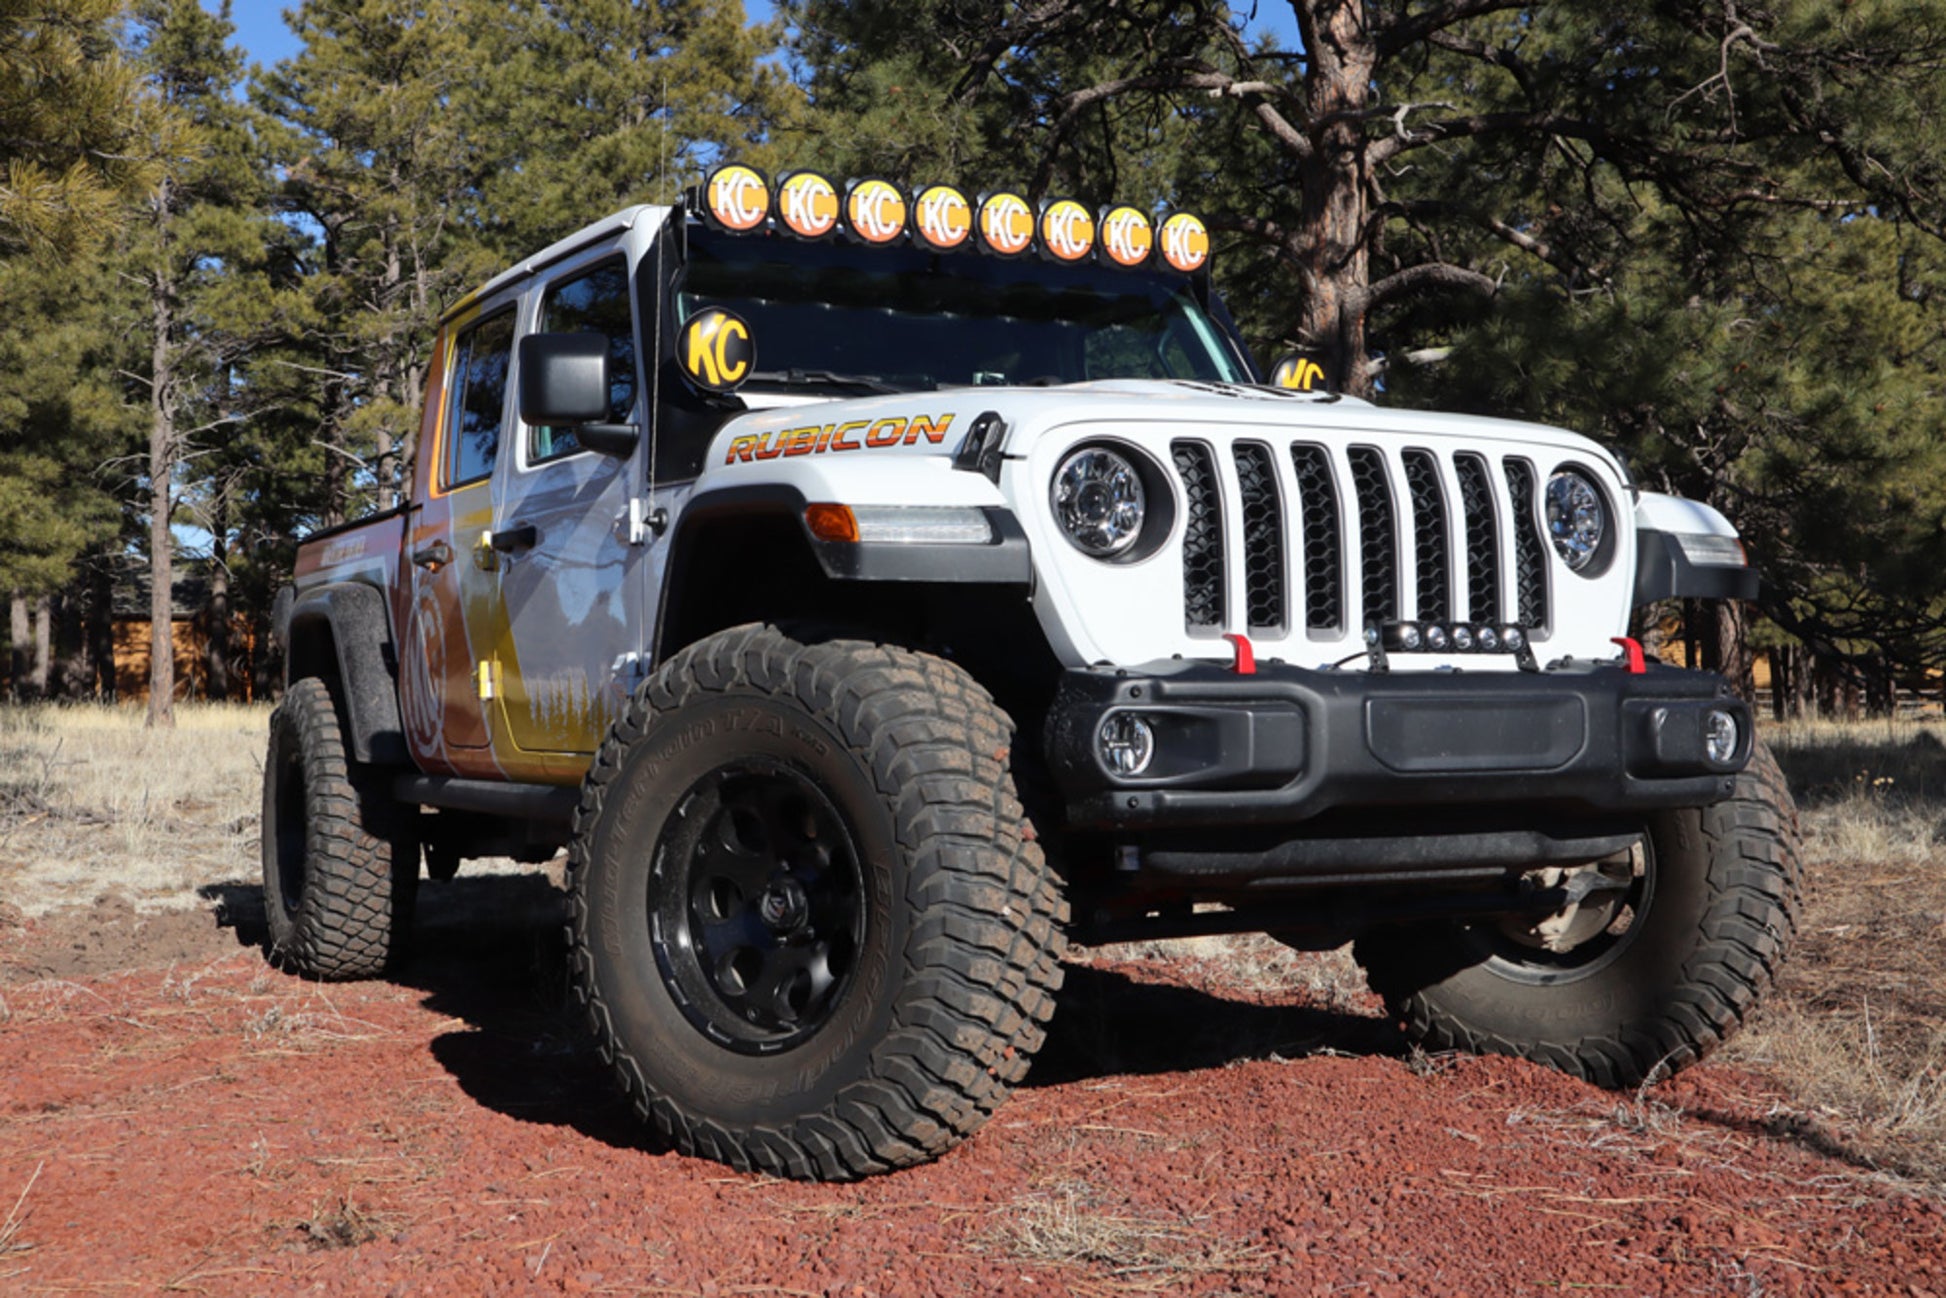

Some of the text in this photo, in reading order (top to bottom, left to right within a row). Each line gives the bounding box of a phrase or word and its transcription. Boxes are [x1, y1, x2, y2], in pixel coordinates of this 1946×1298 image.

[717, 171, 760, 224] KC
[788, 178, 830, 231] KC
[857, 185, 898, 237] KC
[925, 191, 963, 242] KC
[988, 198, 1026, 248] KC
[1051, 205, 1088, 255] KC
[1110, 211, 1145, 260] KC
[1168, 218, 1202, 266] KC
[688, 314, 748, 385] KC
[725, 413, 956, 466] RUBICON
